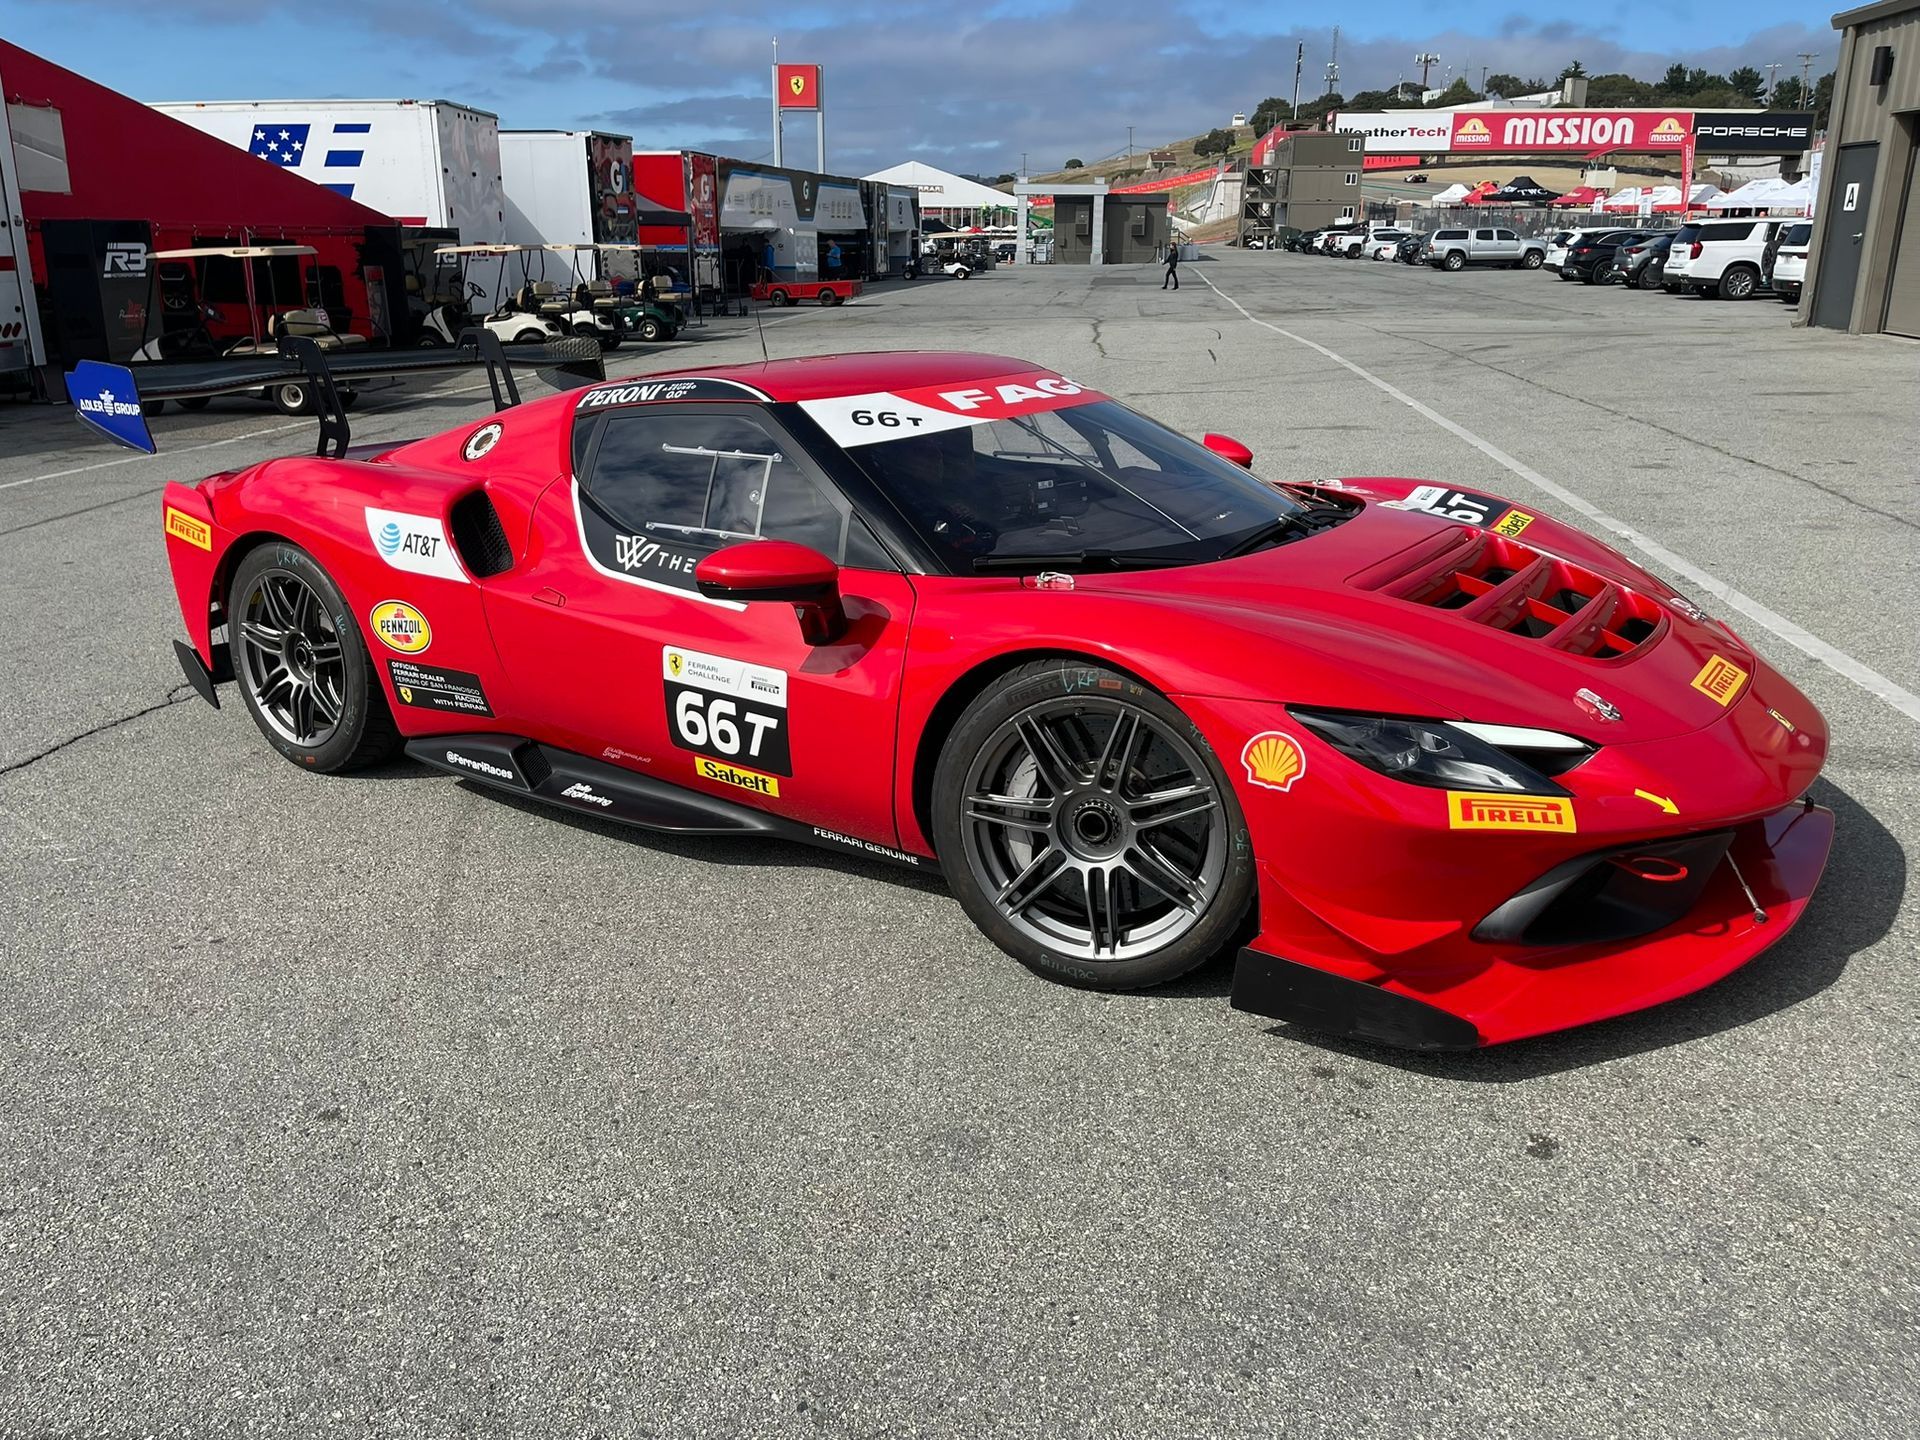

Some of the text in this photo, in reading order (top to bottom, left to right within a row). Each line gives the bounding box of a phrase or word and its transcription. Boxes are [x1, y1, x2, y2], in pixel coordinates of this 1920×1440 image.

[1456, 134, 1490, 143] MISSION
[1503, 117, 1634, 144] MISSION
[1697, 127, 1807, 137] PORSCHE
[1847, 187, 1854, 207] A
[576, 384, 665, 408] PERONI
[80, 399, 141, 417] ADLER GROUP
[171, 513, 206, 544] PIRELLI
[1501, 513, 1528, 537] abelt
[402, 532, 440, 558] AT&T
[658, 551, 697, 573] THE
[380, 619, 422, 634] PENNZOIL
[391, 661, 420, 672] OFFICIAL
[393, 668, 446, 683] FERRARI DEALER
[687, 661, 719, 673] FERRARI
[687, 669, 732, 684] CHALLENGE
[395, 675, 480, 696] FERRARI OF SAN FRANCISCO
[751, 680, 780, 695] PIRELLI
[1700, 661, 1740, 699] PIRELLI
[433, 698, 488, 712] WITH FERRARI
[454, 694, 485, 705] RACING
[676, 690, 778, 756] 66T
[446, 751, 513, 780] @FerrariRaces
[703, 761, 770, 793] Sabelt
[1460, 799, 1563, 825] PIRELLI
[813, 827, 919, 865] FERRARI GENUINE
